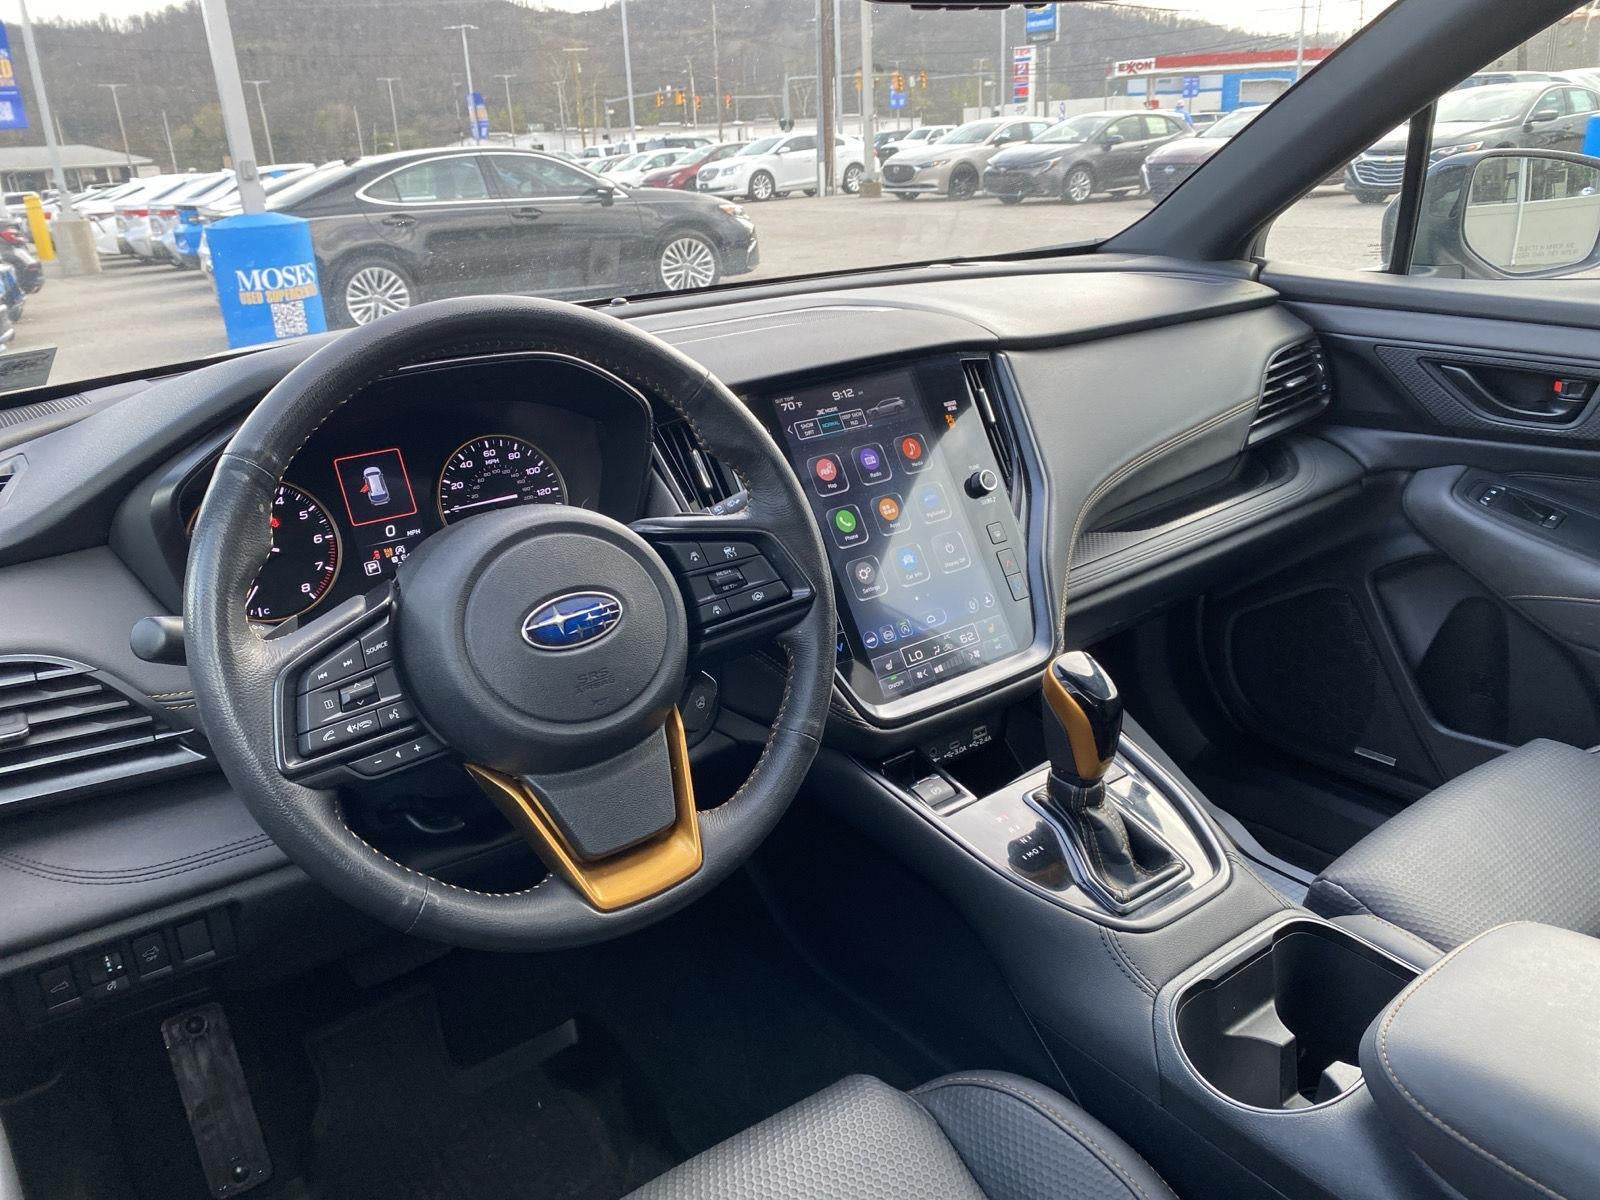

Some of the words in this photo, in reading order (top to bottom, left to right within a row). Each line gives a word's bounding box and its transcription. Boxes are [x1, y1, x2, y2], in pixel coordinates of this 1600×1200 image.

[1118, 61, 1153, 74] EXXON
[234, 262, 316, 292] MOSES
[832, 388, 855, 401] 9:12
[780, 402, 795, 411] 70
[483, 448, 496, 458] 60
[508, 451, 521, 460] 80
[459, 460, 473, 469] 40
[485, 458, 500, 466] MPH
[525, 466, 541, 476] 100
[450, 481, 464, 490] 20
[536, 487, 552, 497] 120
[275, 496, 285, 506] 4
[299, 510, 309, 520] 5
[406, 528, 421, 537] MPH
[313, 533, 323, 544] 6
[845, 534, 859, 542] Phone
[314, 561, 324, 572] 7
[300, 582, 311, 593] 8
[862, 585, 881, 595] Settings
[959, 632, 976, 644] 62
[366, 641, 388, 655] SOURCE
[908, 650, 924, 663] LO
[577, 667, 611, 682] SRS
